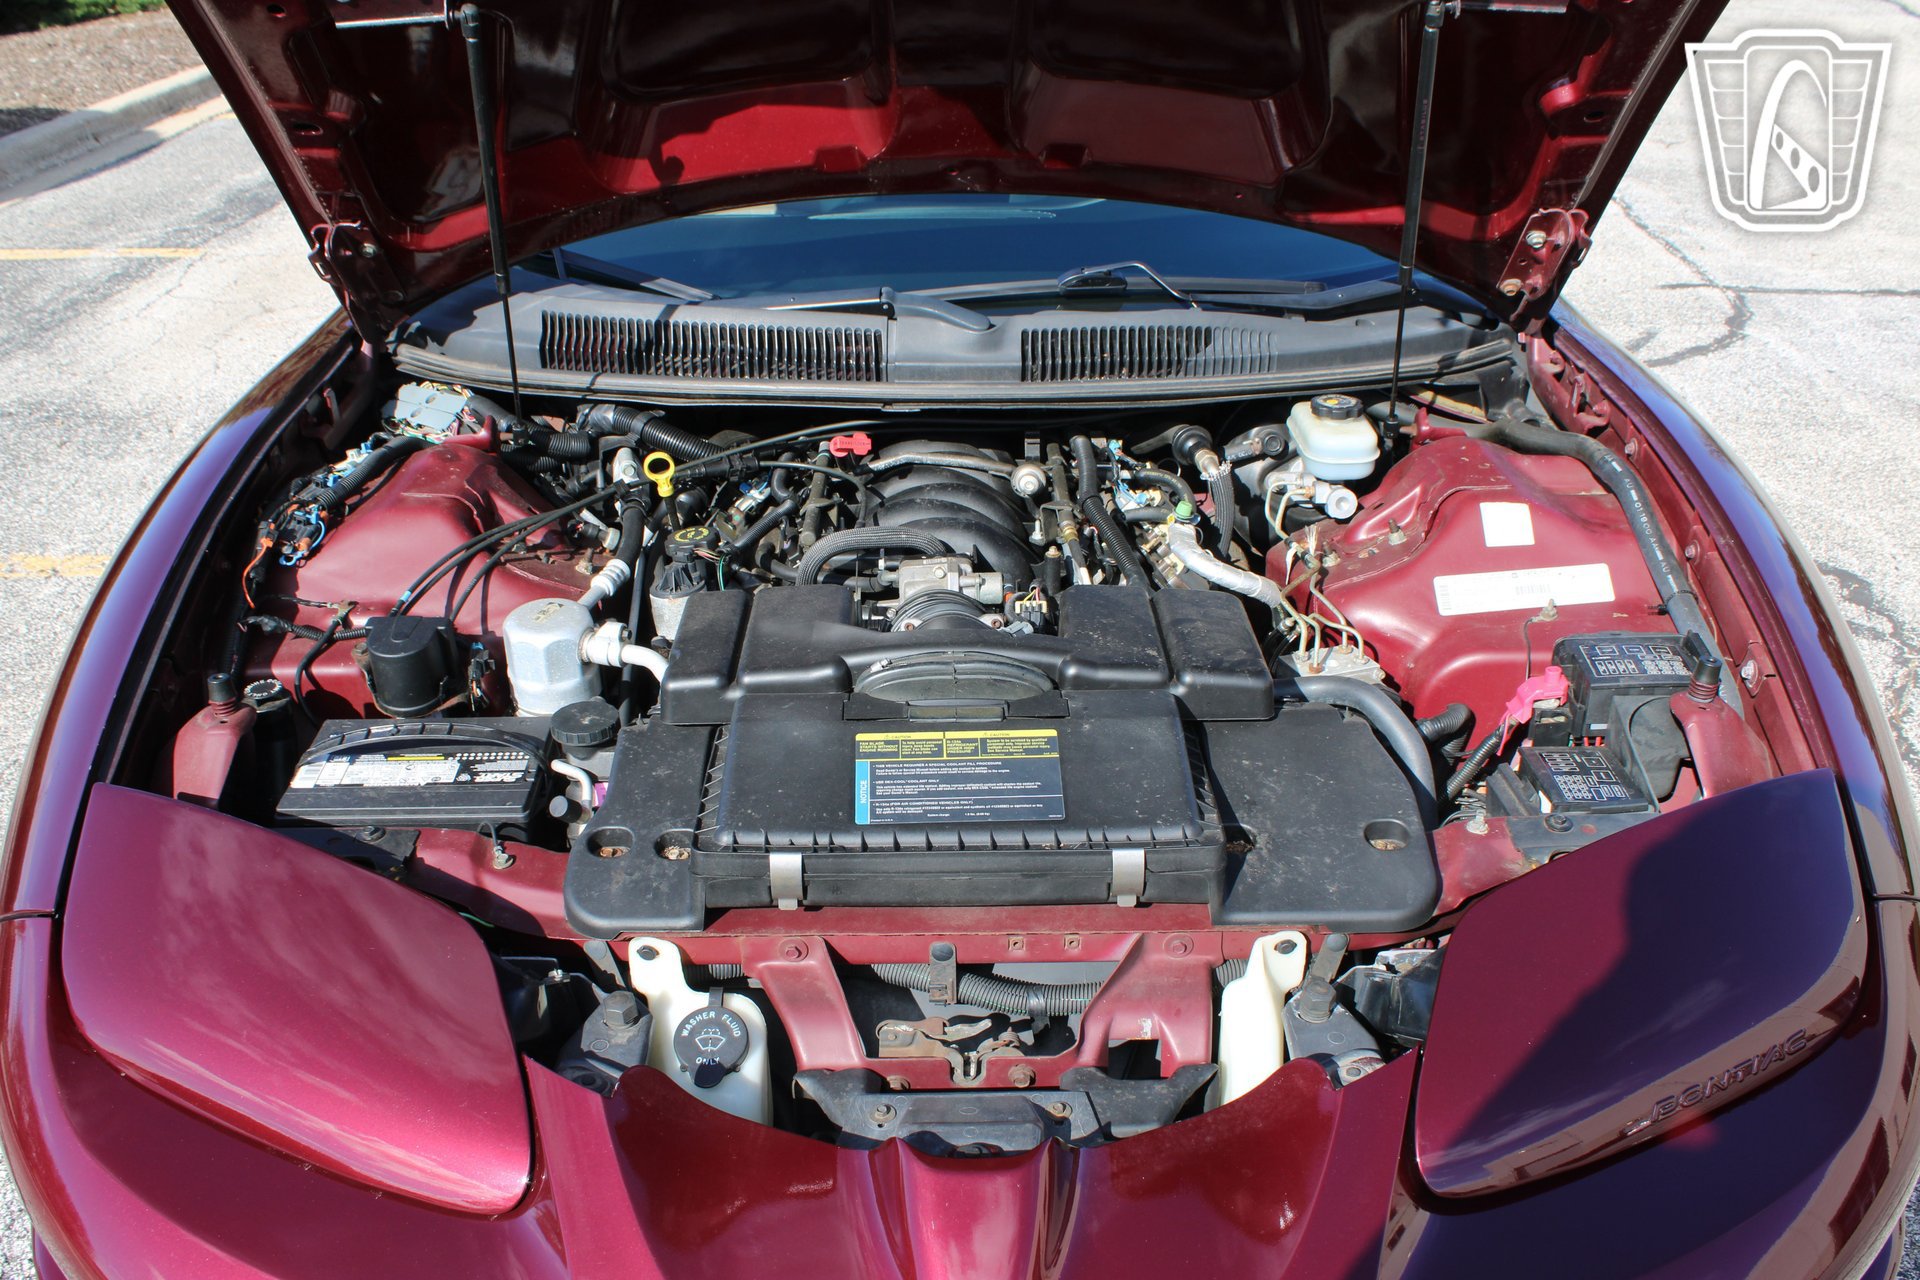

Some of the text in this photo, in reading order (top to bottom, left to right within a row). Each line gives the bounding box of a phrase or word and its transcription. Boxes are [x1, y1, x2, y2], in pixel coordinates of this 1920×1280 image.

[681, 1011, 741, 1037] WASHER FLUID
[696, 1056, 720, 1066] ONLY
[1648, 1028, 1808, 1123] PONTIAC
